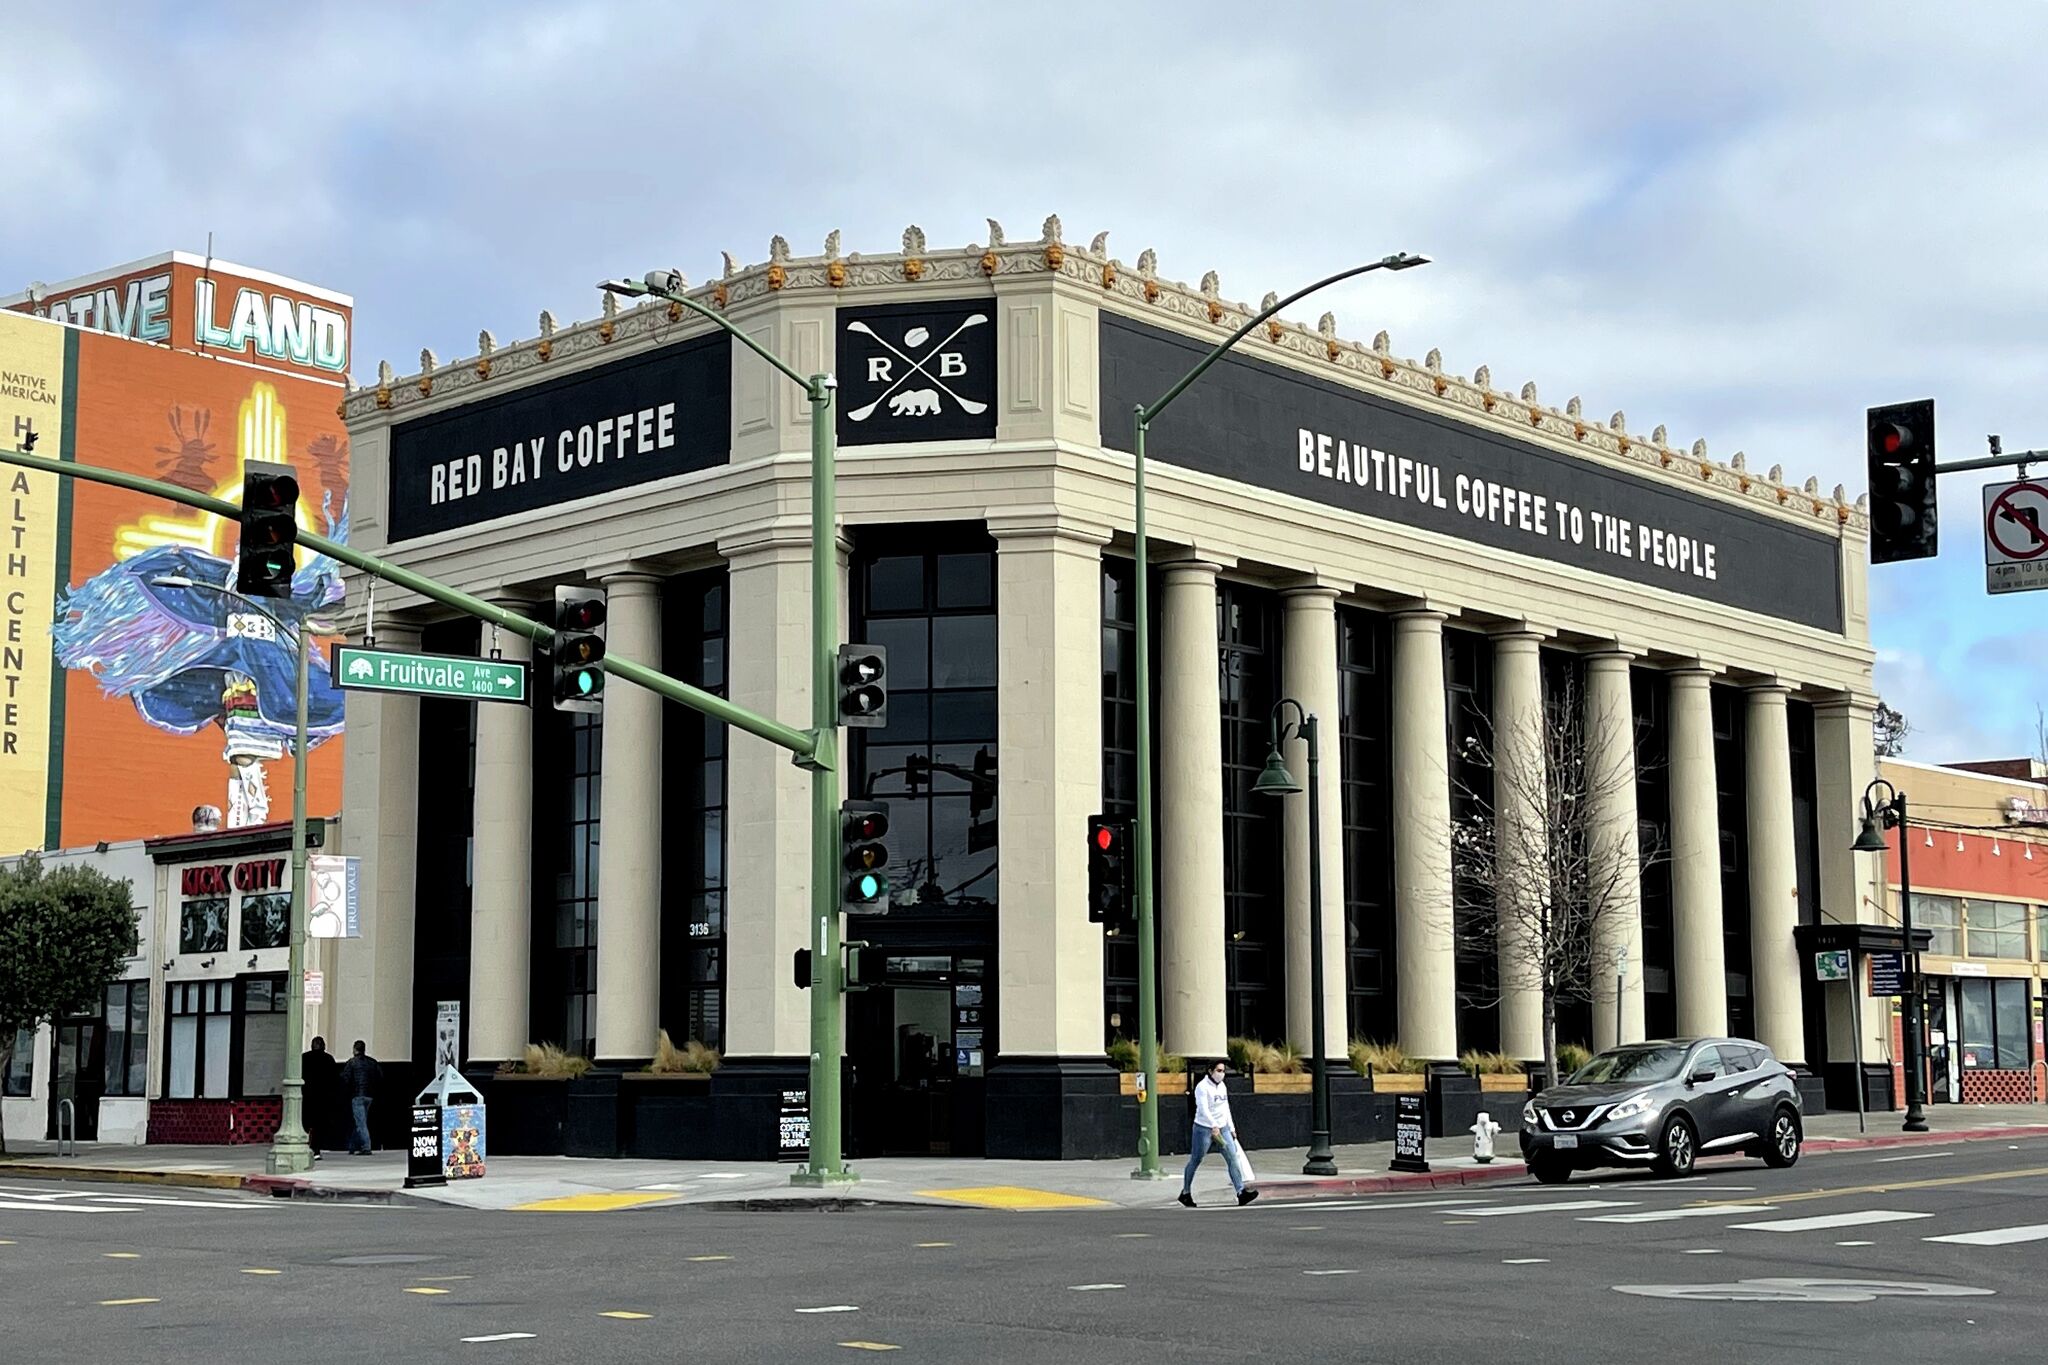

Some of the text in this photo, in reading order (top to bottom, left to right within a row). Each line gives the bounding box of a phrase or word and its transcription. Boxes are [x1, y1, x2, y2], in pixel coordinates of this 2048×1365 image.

[193, 276, 349, 374] LAND
[867, 352, 968, 382] R B
[2, 370, 47, 390] NATIVE
[0, 384, 57, 406] MERICAN
[431, 402, 676, 505] RED BAY COFFEE
[1298, 427, 1717, 581] BEAUTIFUL COFFEE TO THE PEOPLE
[2021, 562, 2032, 573] TO
[3, 591, 26, 755] CENTER
[379, 659, 466, 689] Fruitvale
[472, 665, 491, 679] Ave
[471, 679, 493, 694] 1400
[181, 858, 286, 898] KICK CITY
[347, 864, 358, 930] FRUITVALE
[689, 922, 709, 936] 3136
[780, 1123, 811, 1132] COFFEE
[780, 1131, 807, 1139] TO THE
[1397, 1130, 1422, 1140] COFFEE
[413, 1135, 438, 1148] NOW
[780, 1138, 811, 1148] PEOPLE
[412, 1146, 438, 1158] OPEN
[1397, 1145, 1422, 1156] PEOPLE
